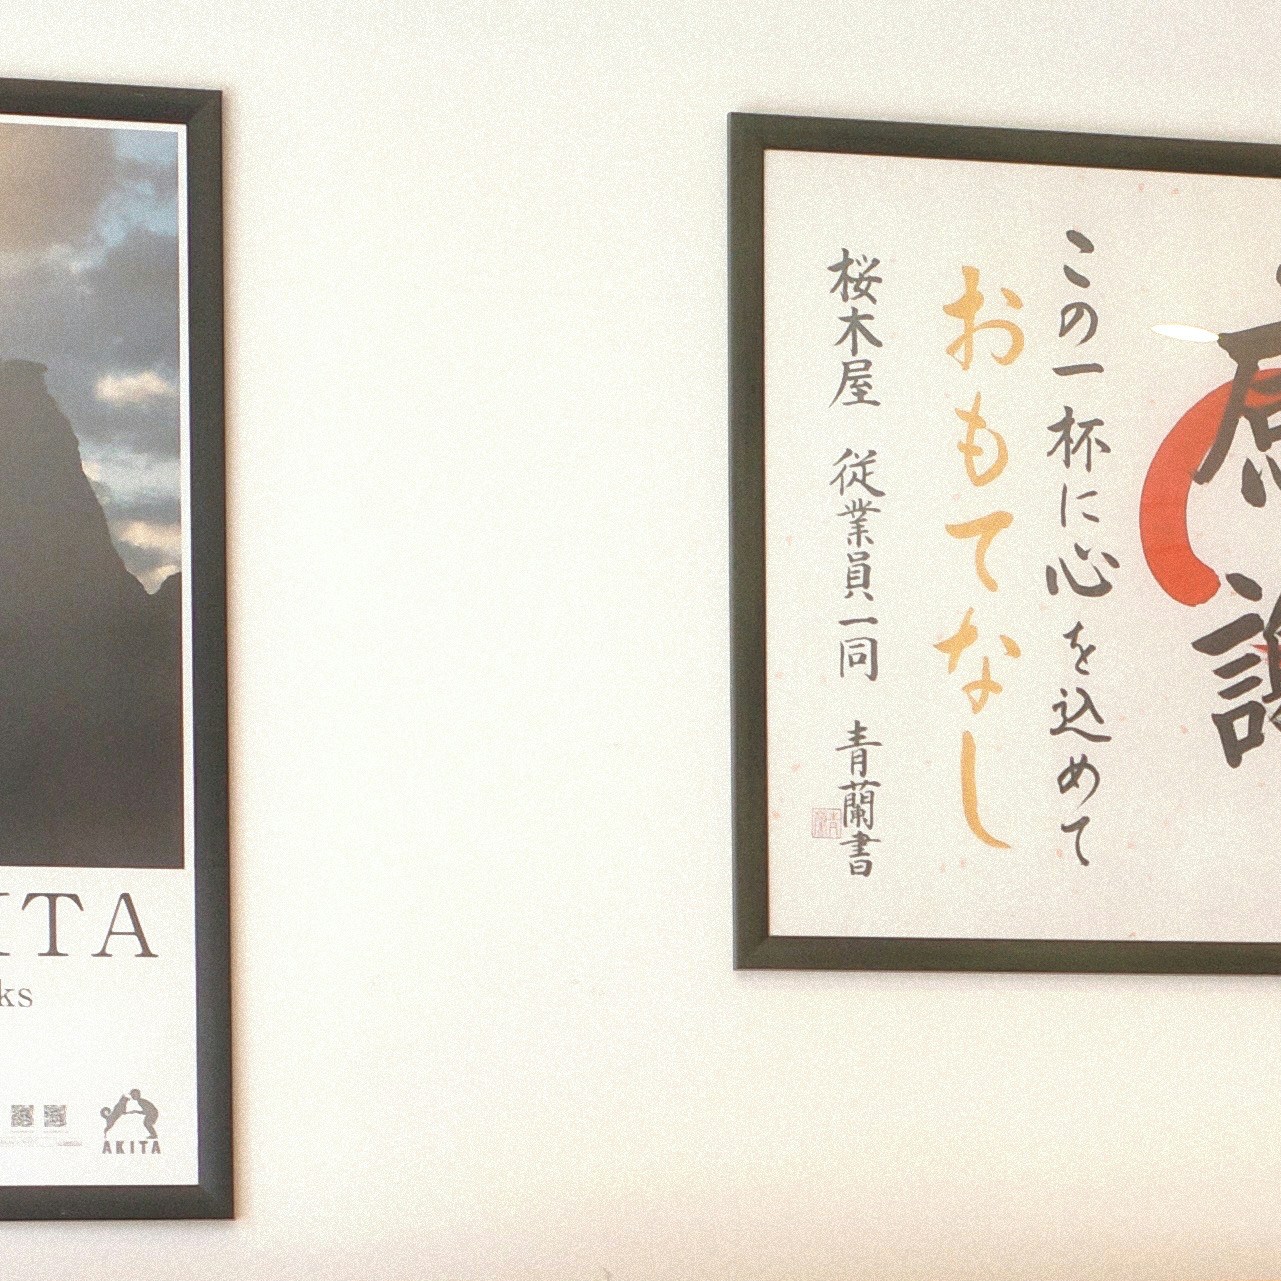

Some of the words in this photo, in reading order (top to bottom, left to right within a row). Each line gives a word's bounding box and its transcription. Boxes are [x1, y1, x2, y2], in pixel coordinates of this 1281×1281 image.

[827, 248, 883, 408] 桜木屋
[829, 448, 886, 682] 従業員一同
[932, 265, 1026, 850] おもてなし
[1045, 229, 1121, 867] この一杯に心を込めて
[835, 720, 883, 878] 青蘭書
[102, 1140, 161, 1155] AKITA
